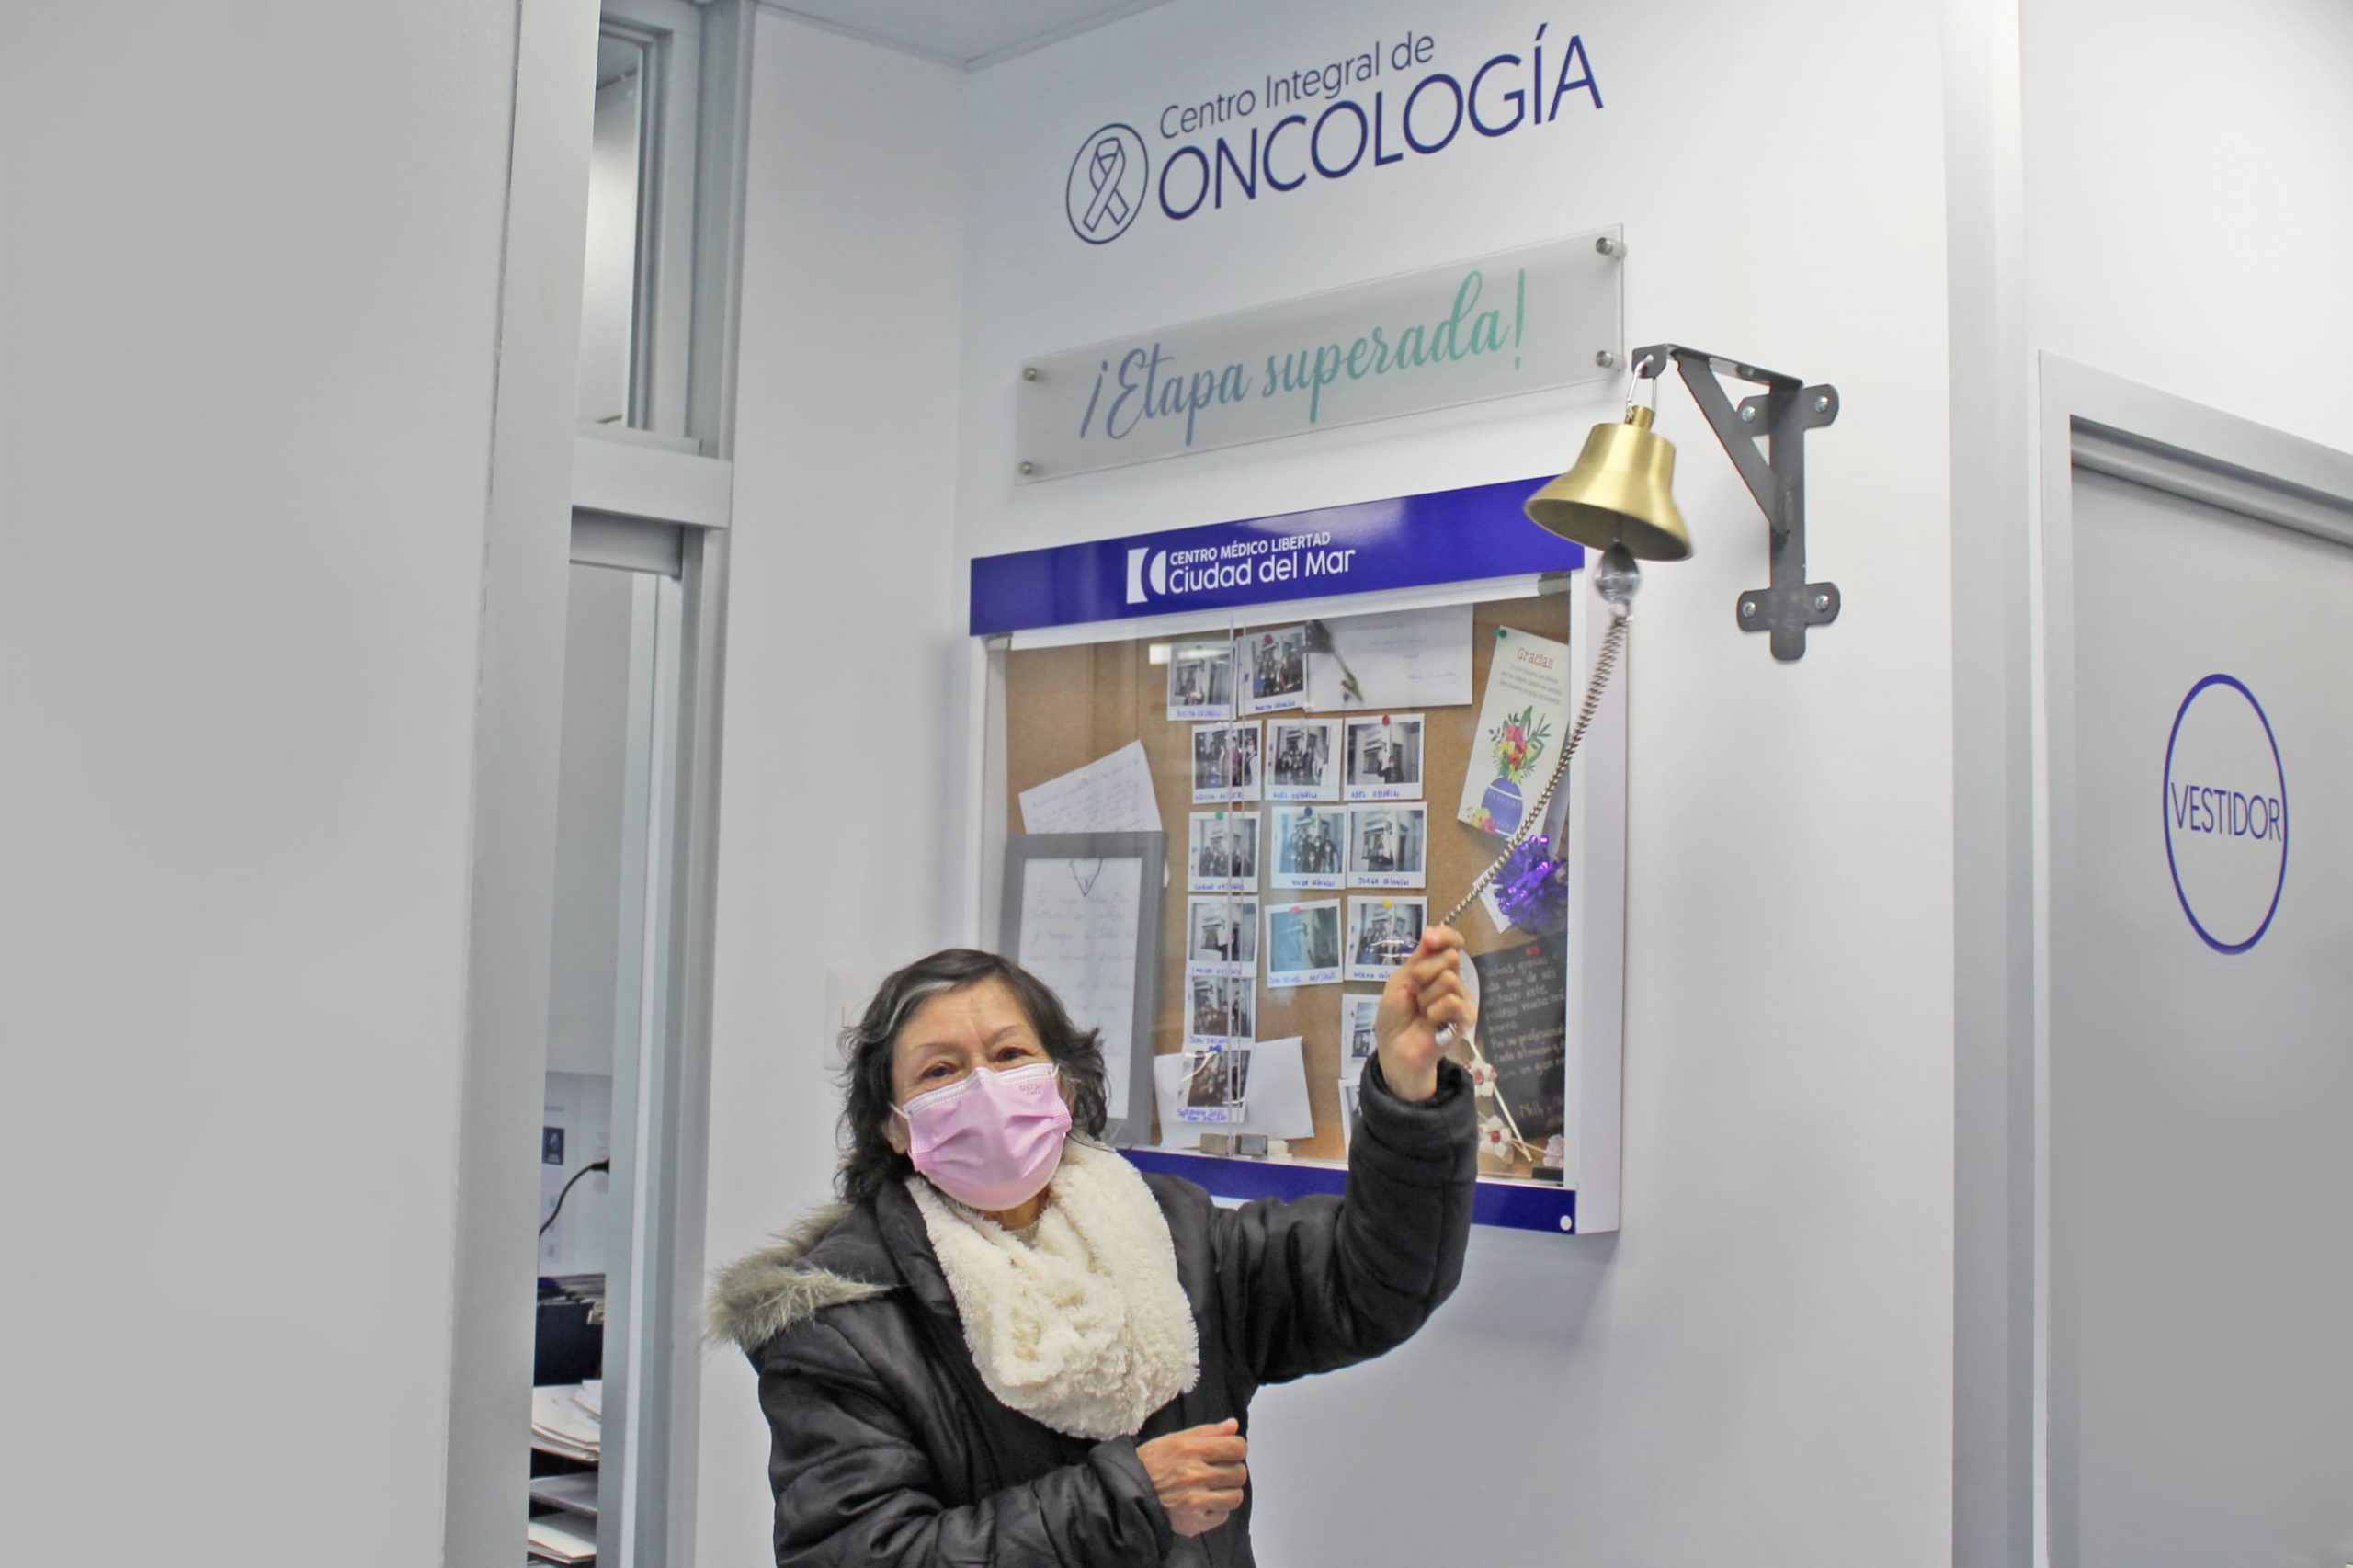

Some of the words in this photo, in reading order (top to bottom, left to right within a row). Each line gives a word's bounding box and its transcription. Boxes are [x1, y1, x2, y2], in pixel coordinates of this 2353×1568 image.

[1160, 89, 1256, 140] Centro
[1265, 40, 1381, 109] Integral
[1391, 31, 1436, 71] de
[1157, 22, 1605, 221] ONCOLOGÍA
[1079, 342, 1251, 447] ¡Etapa
[1261, 267, 1526, 425] superada!
[1169, 547, 1218, 566] CENTRO
[1220, 539, 1268, 560] MÉDICO
[1271, 531, 1332, 553] LIBERTAD
[1169, 557, 1252, 595] Ciudad
[1258, 551, 1298, 583] del
[1304, 549, 1357, 578] Mar
[1518, 647, 1554, 670] Gracias
[2170, 781, 2282, 842] VESTIDOR
